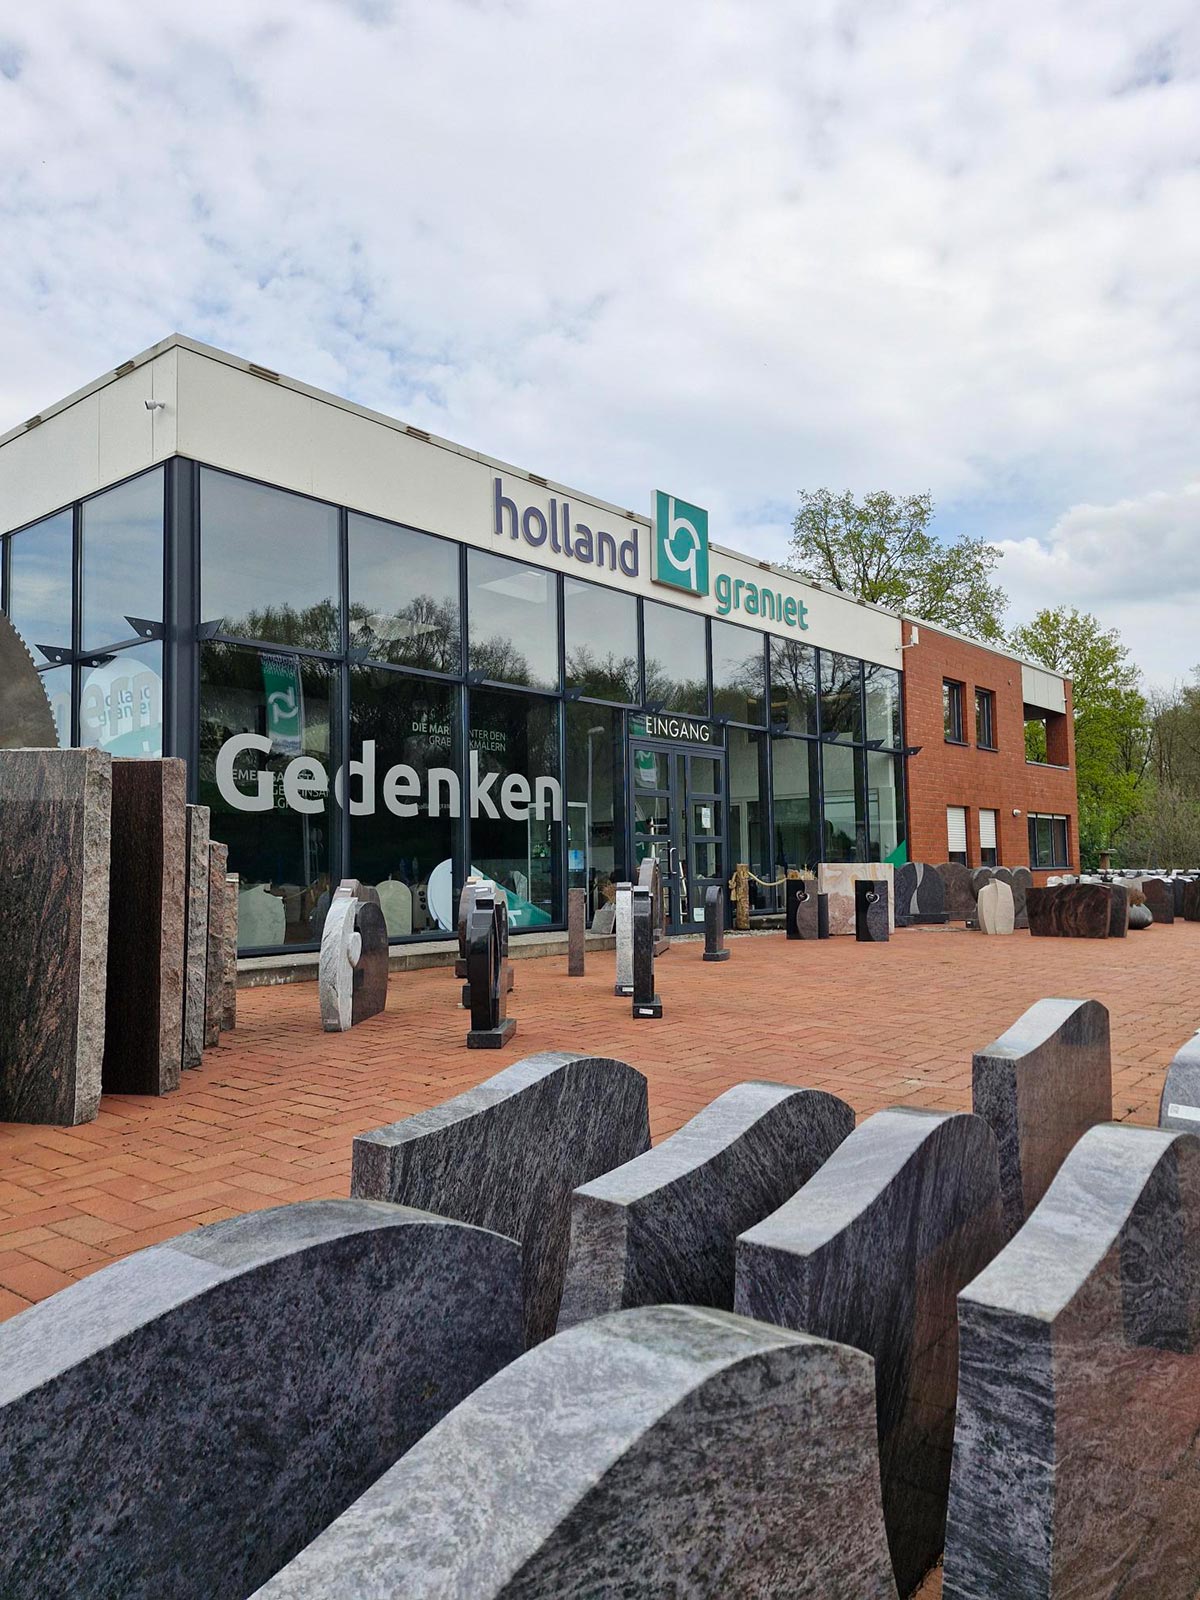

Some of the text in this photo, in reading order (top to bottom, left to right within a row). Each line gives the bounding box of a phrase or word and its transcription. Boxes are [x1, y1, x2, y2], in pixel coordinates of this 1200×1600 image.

[494, 477, 639, 578] holland
[714, 573, 809, 631] graniet
[412, 722, 428, 733] DIE
[490, 731, 506, 742] DEN
[645, 715, 710, 742] EINGANG
[215, 733, 561, 821] Gedenken
